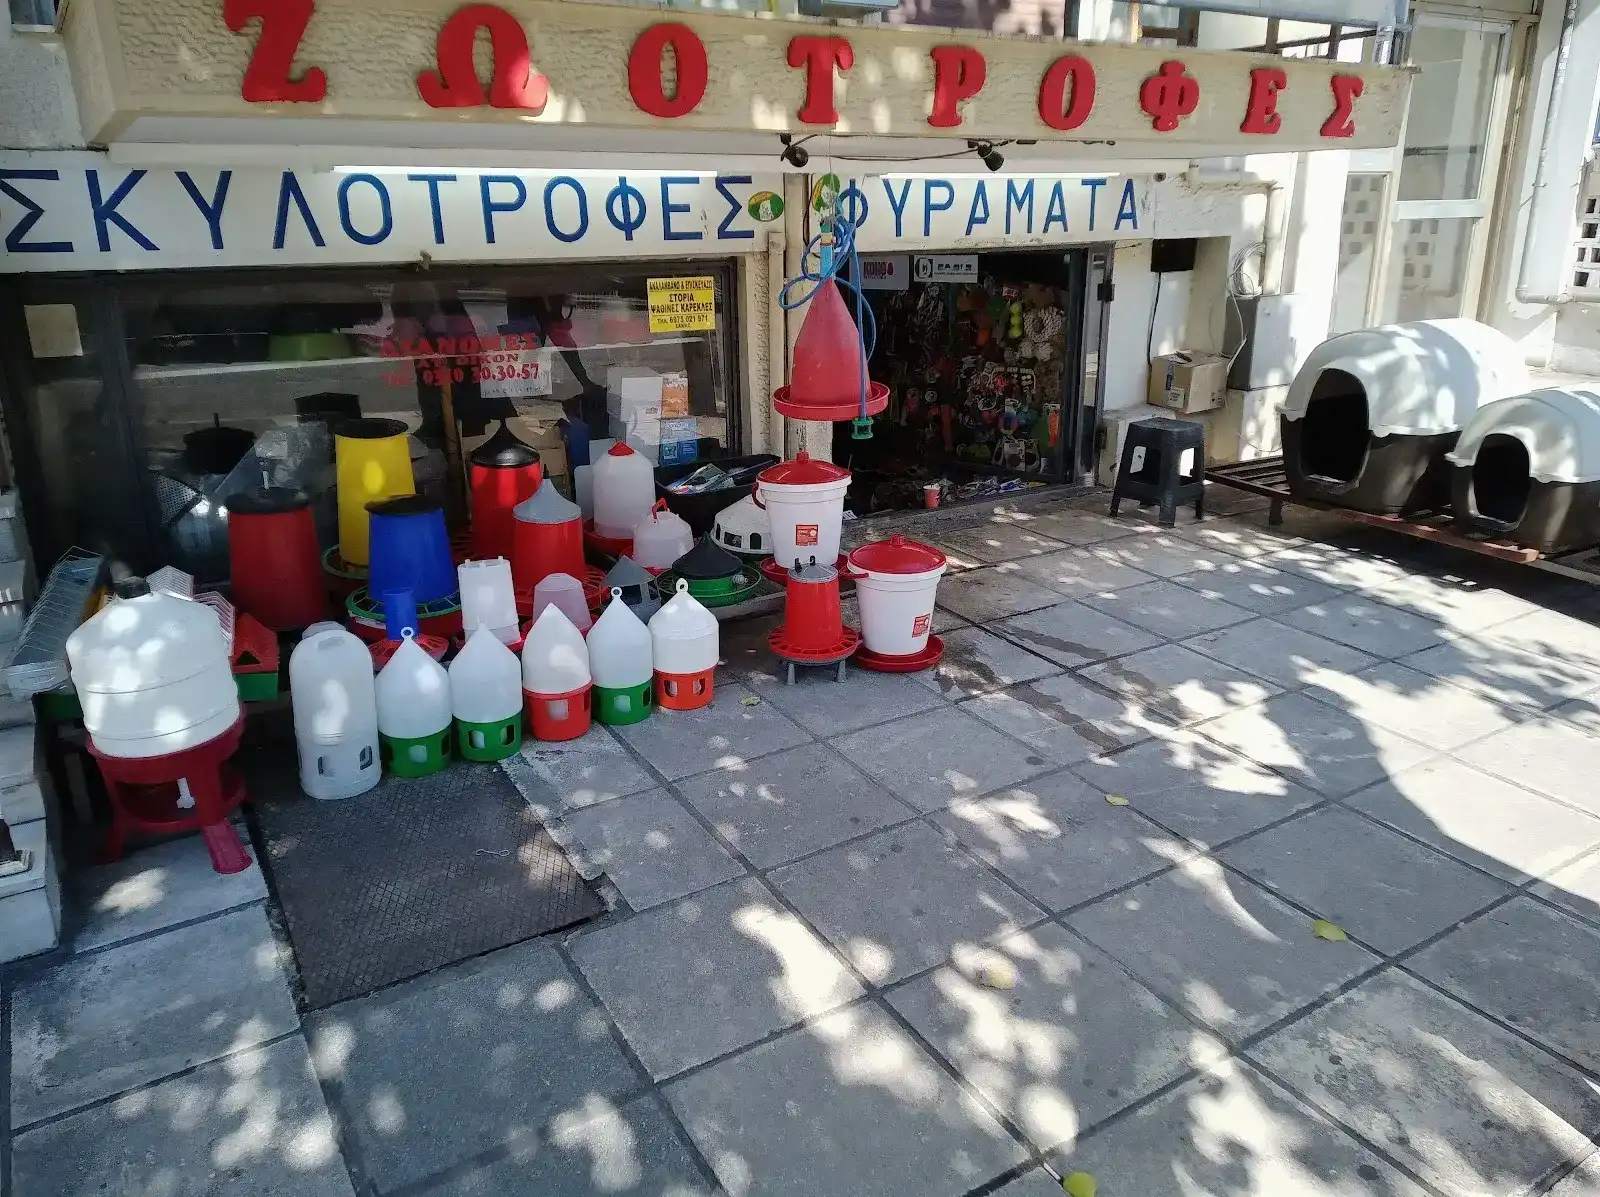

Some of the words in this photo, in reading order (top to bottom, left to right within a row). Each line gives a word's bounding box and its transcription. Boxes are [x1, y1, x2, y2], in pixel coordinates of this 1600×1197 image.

[223, 0, 1364, 138] ΖΩΟΤΡΟΦΕΣ
[0, 168, 755, 254] ΣΚΥΛΟΤΡΟΦΕΣ
[837, 177, 1138, 238] ΦΥΡΑΜΑΤΑ
[651, 303, 680, 314] ΨΑΘΙΝΕΣ
[680, 302, 713, 313] ΚΑΡΕΚΛΕΣ
[669, 293, 695, 303] ΣΤΟΡΙΑ
